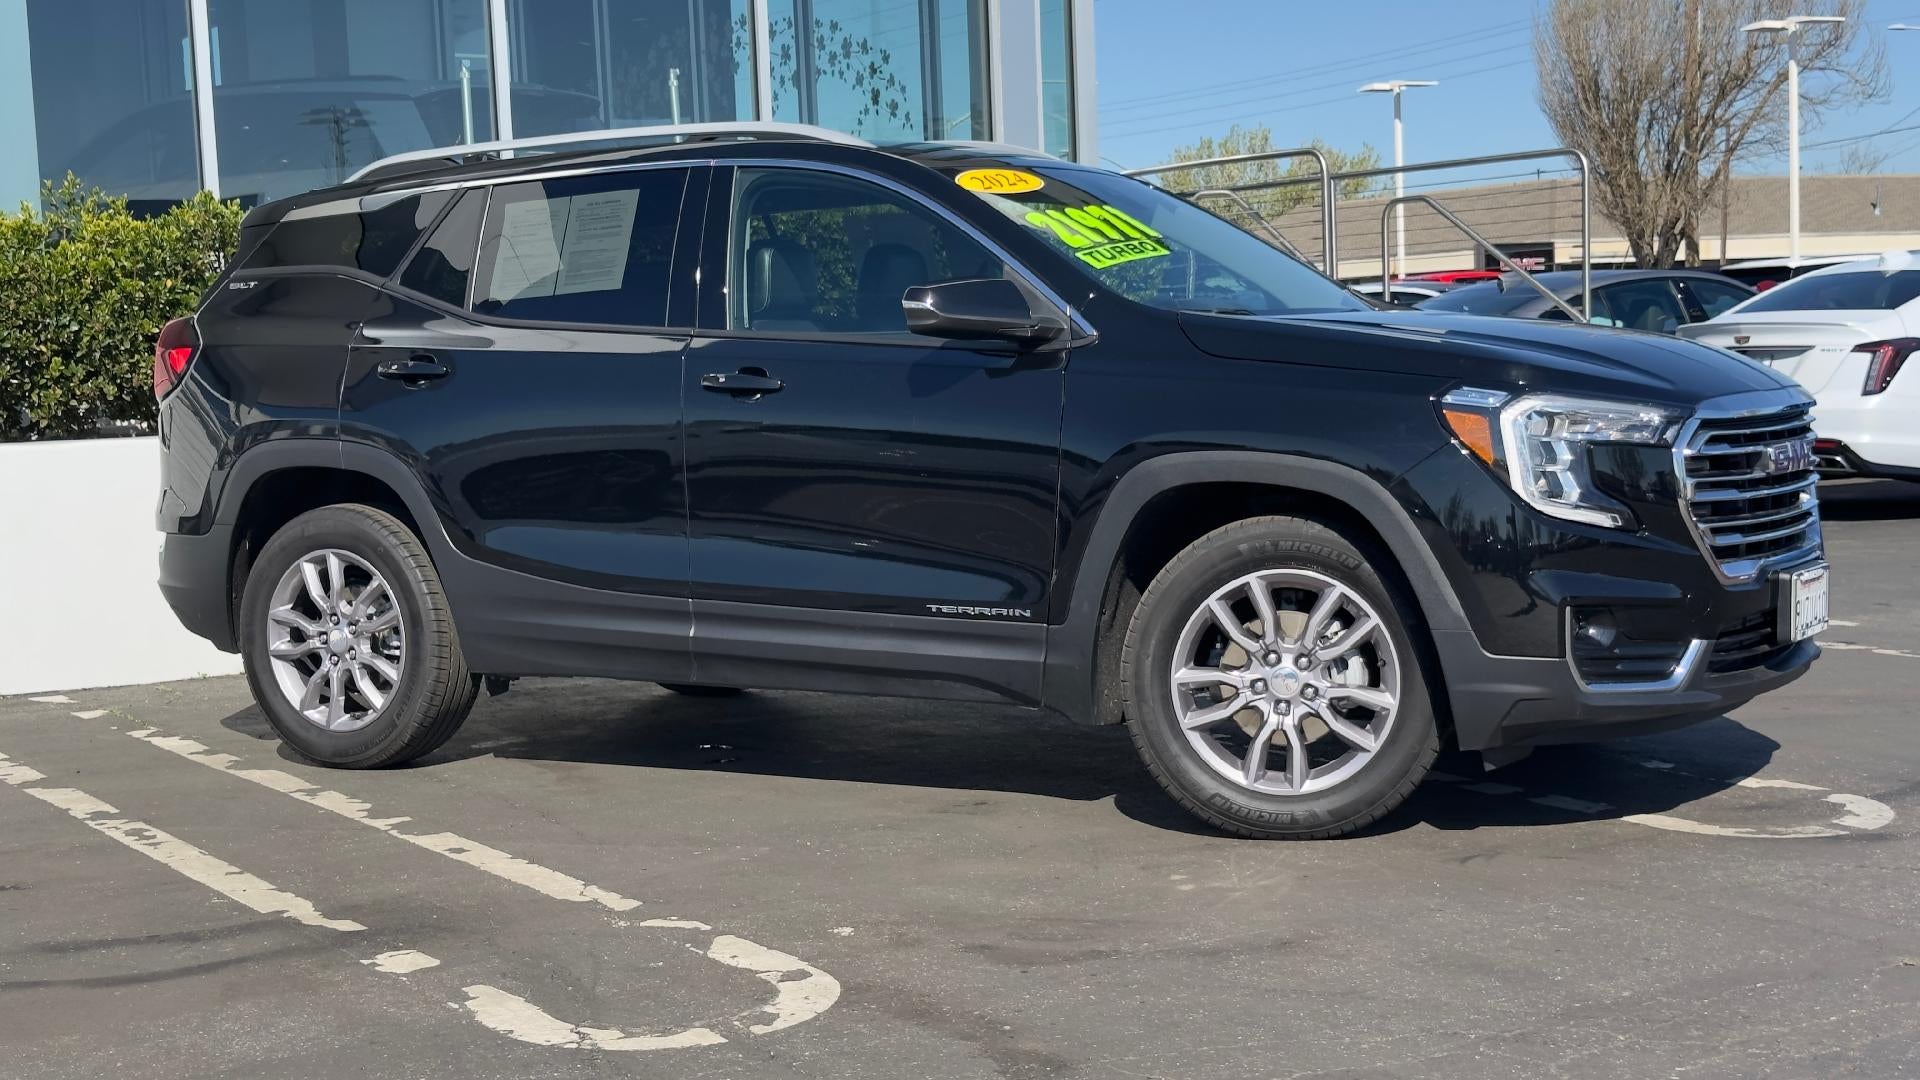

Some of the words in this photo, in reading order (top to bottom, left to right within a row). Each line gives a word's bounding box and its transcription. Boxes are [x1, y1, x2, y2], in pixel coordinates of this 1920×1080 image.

[970, 172, 1029, 190] 2024
[1082, 241, 1158, 263] TURBO
[229, 281, 259, 290] SLT
[1277, 540, 1360, 569] MICHELIN
[926, 604, 1032, 618] TERRAIN
[1210, 795, 1293, 825] MICHELIN
